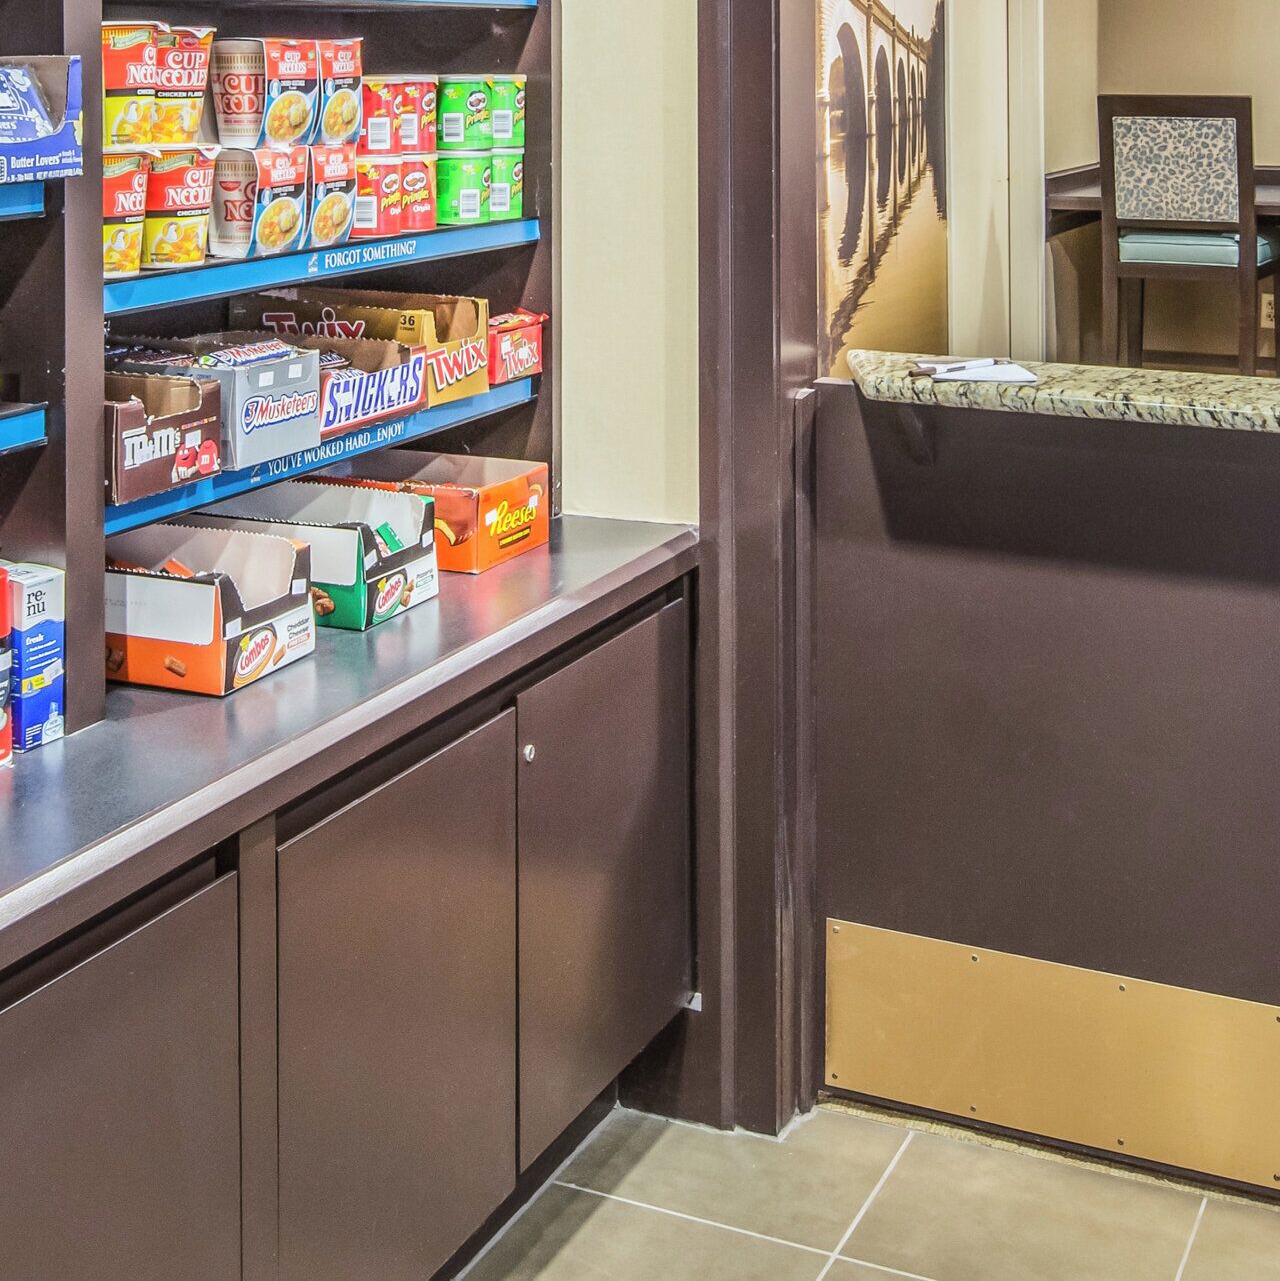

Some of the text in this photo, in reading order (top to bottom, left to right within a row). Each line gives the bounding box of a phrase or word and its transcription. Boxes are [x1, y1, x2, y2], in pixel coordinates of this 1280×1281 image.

[166, 50, 206, 72] CUP
[11, 154, 63, 169] Butter Lovers
[402, 189, 431, 210] Pringles
[325, 239, 417, 268] FORGOT SOMETHING?
[400, 314, 415, 327] 36
[428, 337, 489, 391] Twix
[257, 391, 318, 422] Musketeers
[324, 354, 423, 428] SNICKERS
[269, 454, 302, 476] YOU'VE
[303, 441, 344, 470] WORKED
[488, 501, 538, 537] Reese's
[25, 600, 47, 618] nu
[377, 577, 404, 612] Combos
[240, 639, 271, 671] Combos
